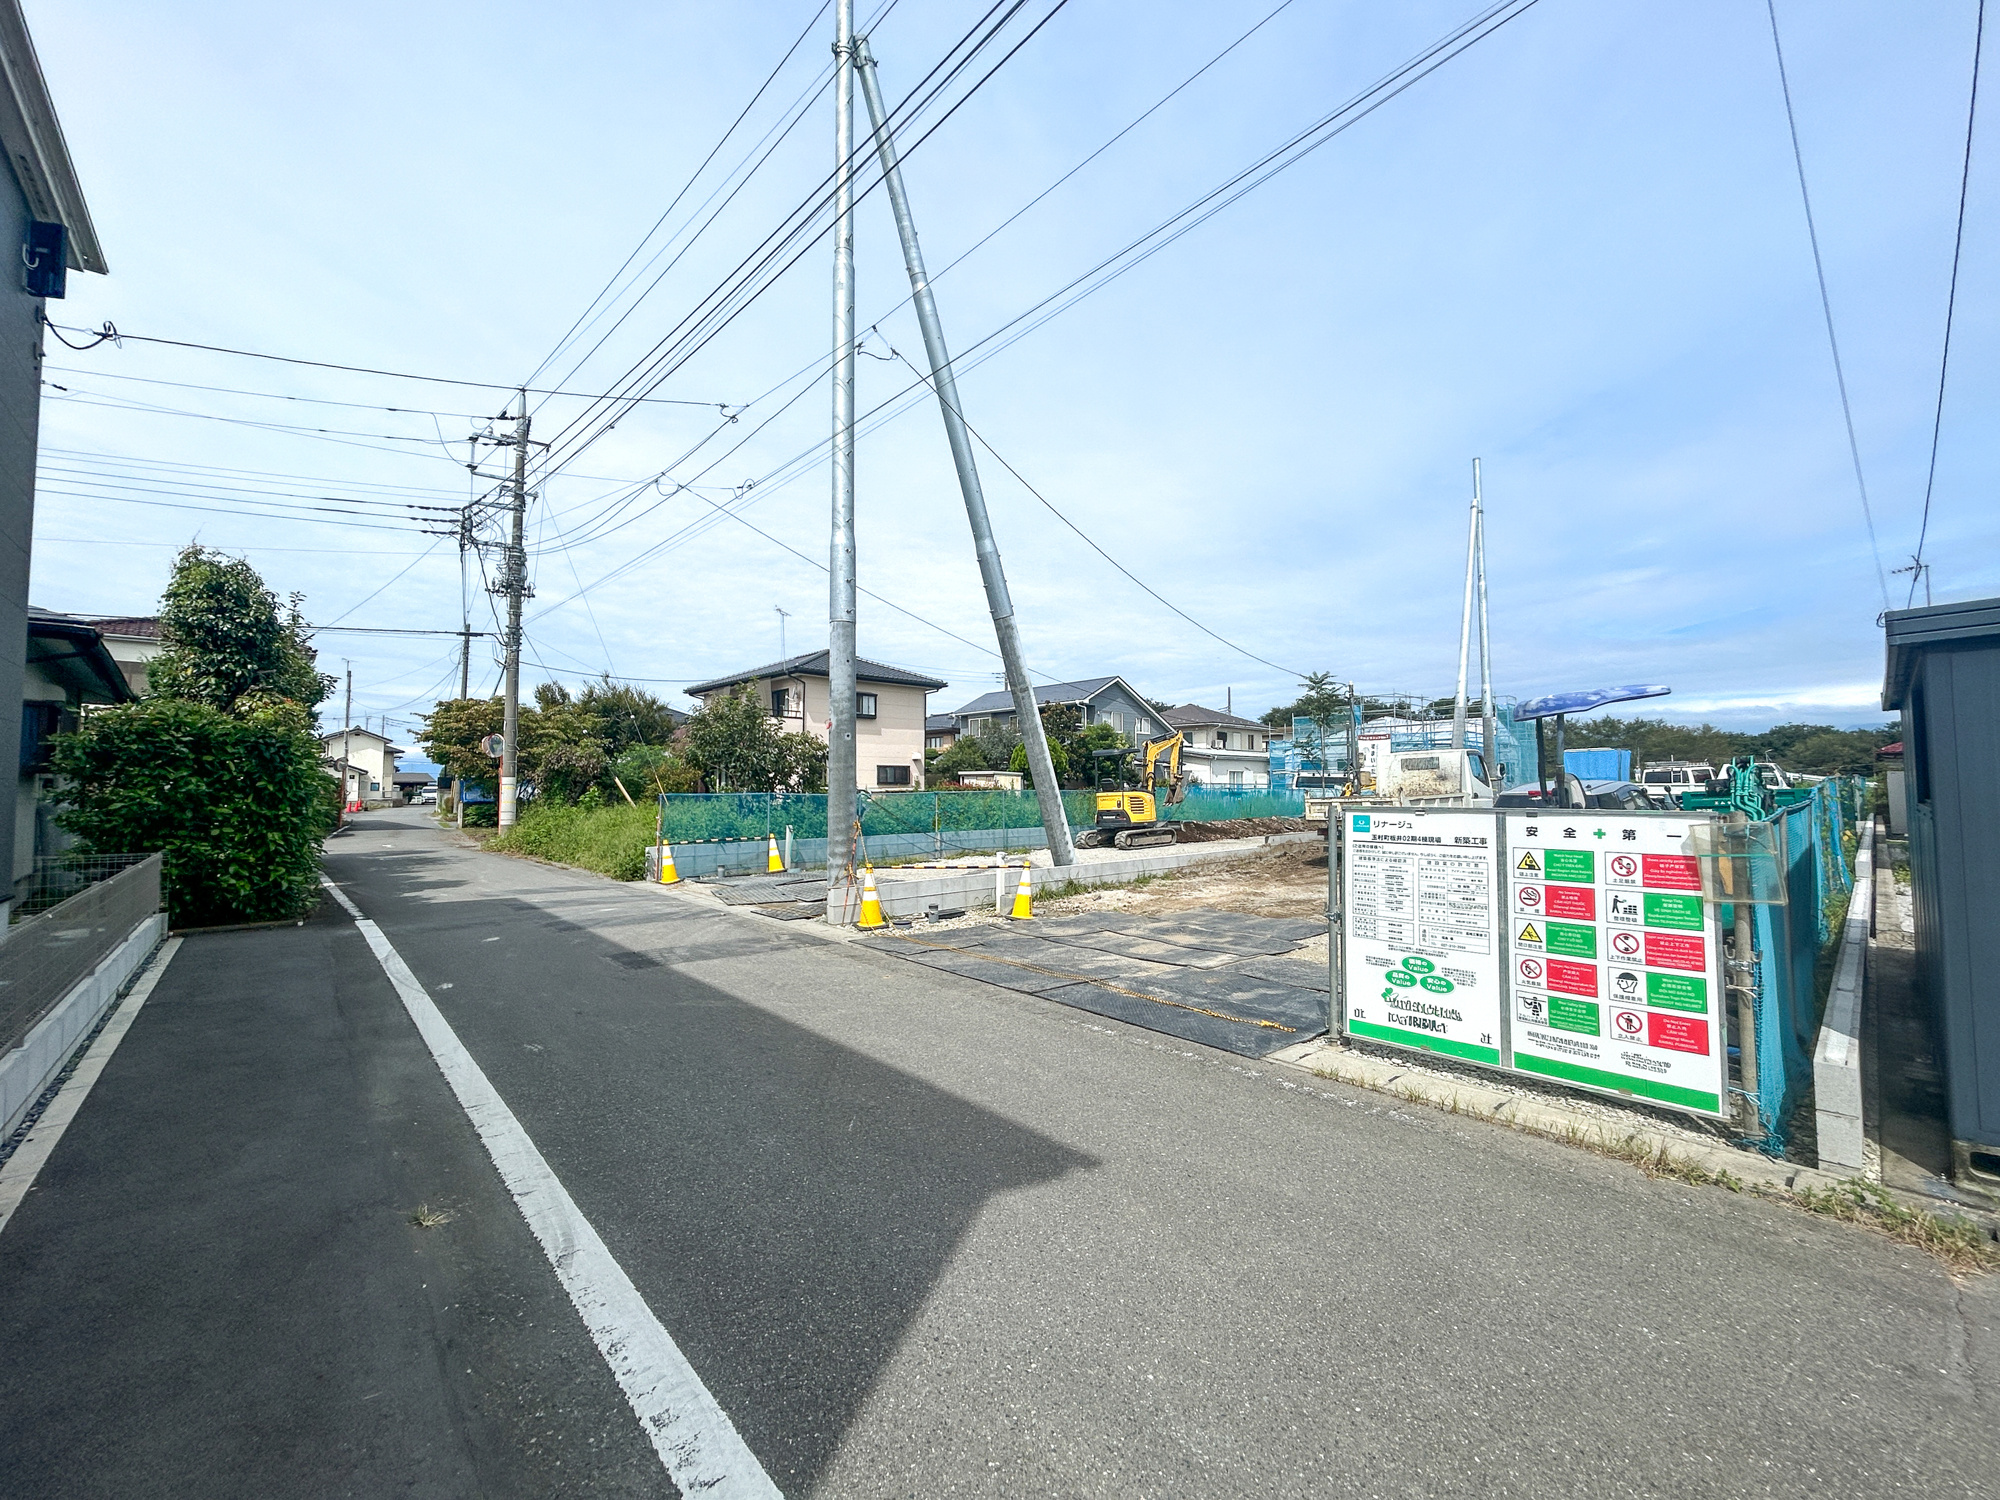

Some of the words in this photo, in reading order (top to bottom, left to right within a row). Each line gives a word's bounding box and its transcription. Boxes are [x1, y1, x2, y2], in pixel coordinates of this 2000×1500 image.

[1373, 820, 1413, 829] リナージュ
[1454, 836, 1488, 845] 新築工事
[1408, 964, 1429, 973] Value
[1391, 977, 1411, 986] Value
[1426, 983, 1448, 992] Value
